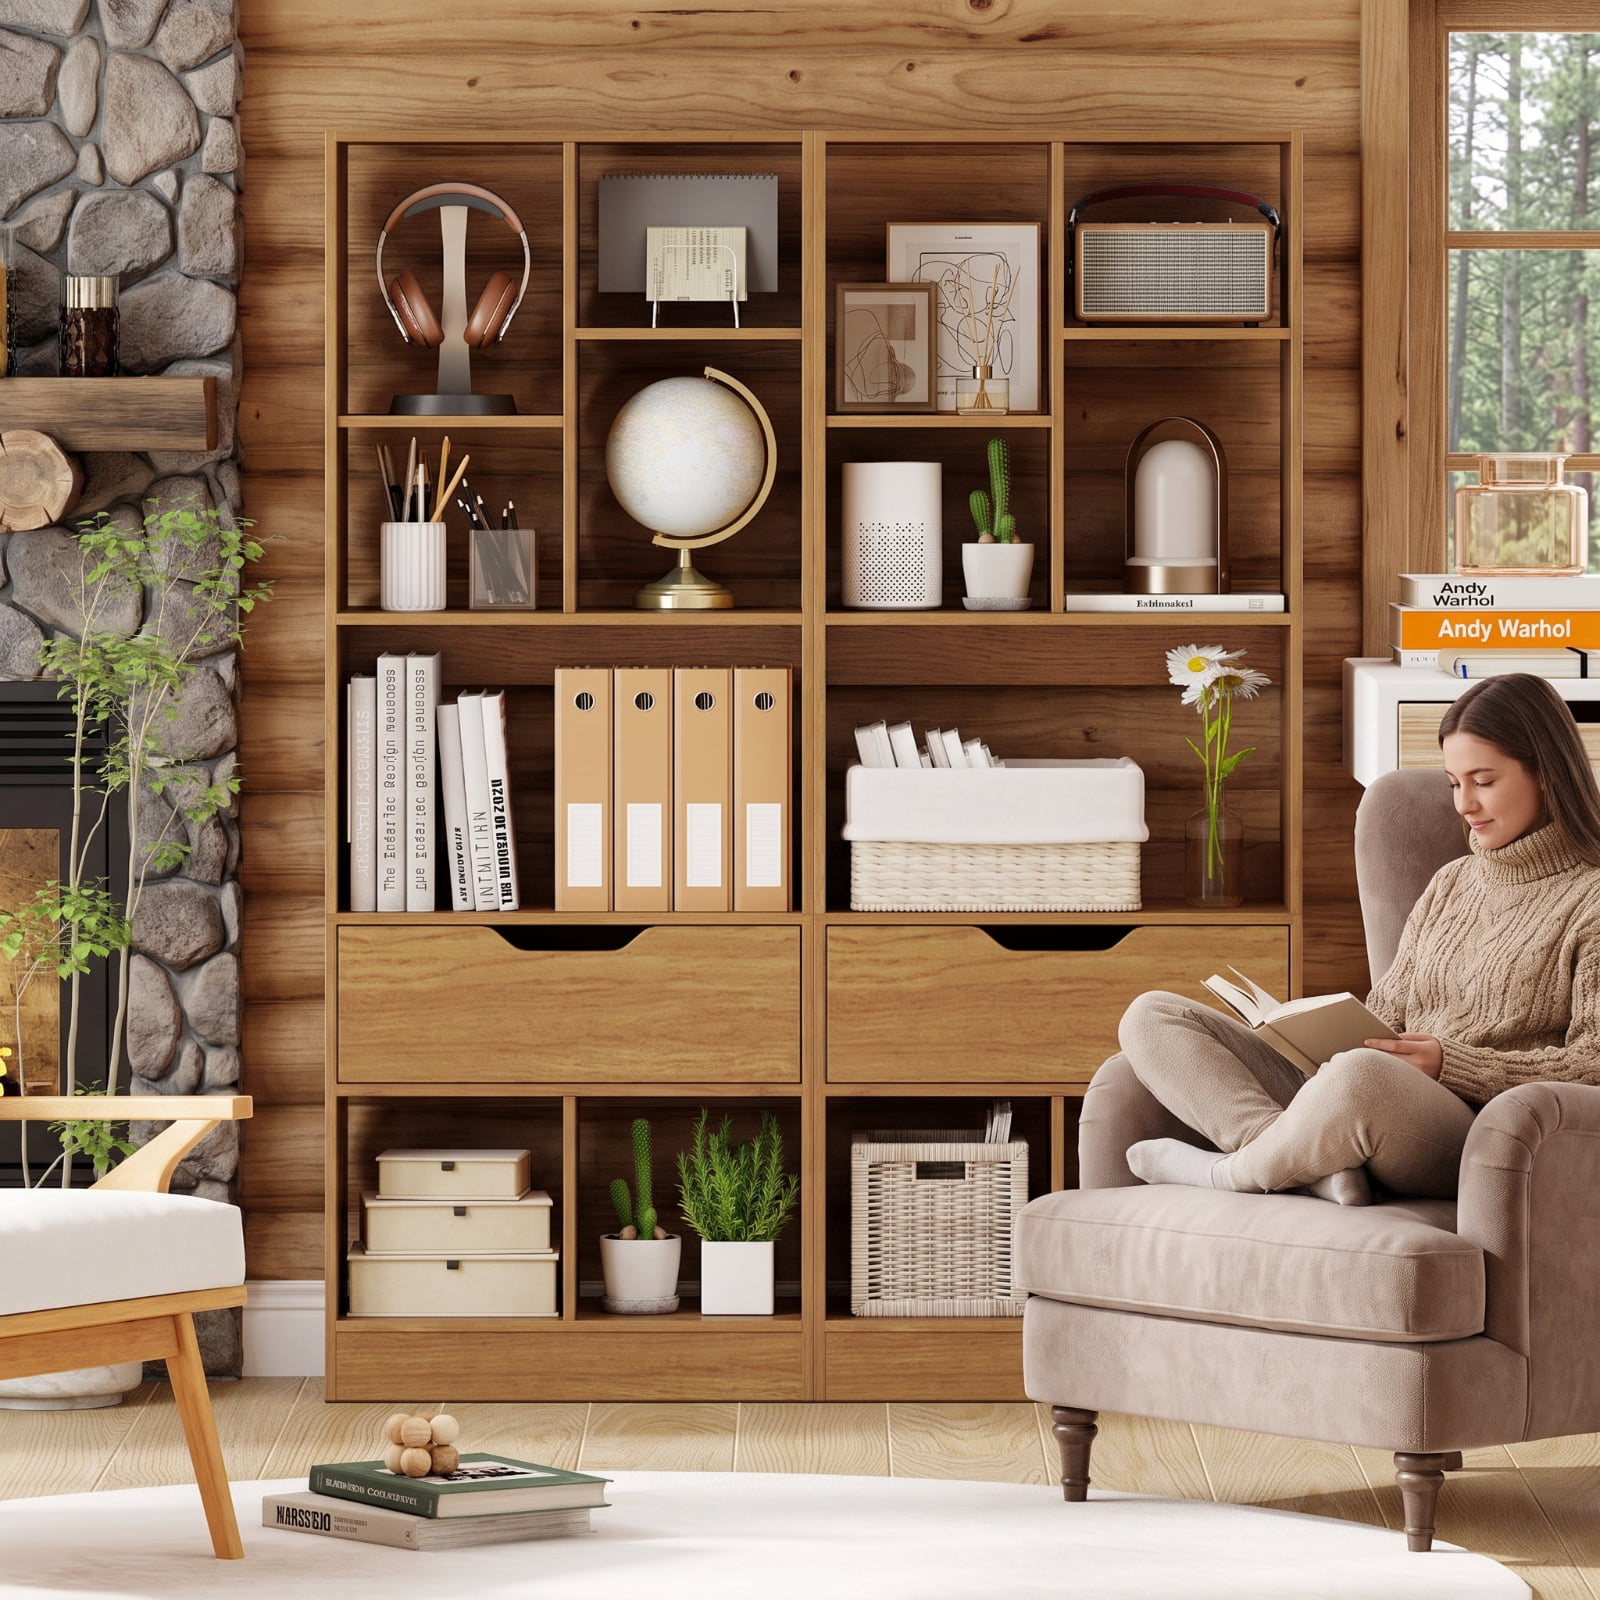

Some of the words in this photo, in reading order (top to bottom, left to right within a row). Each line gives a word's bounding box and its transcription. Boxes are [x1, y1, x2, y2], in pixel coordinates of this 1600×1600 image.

[1440, 582, 1487, 596] Andy
[1432, 595, 1494, 606] Warhol
[1437, 618, 1493, 643] Andy
[1497, 618, 1571, 638] Warhol
